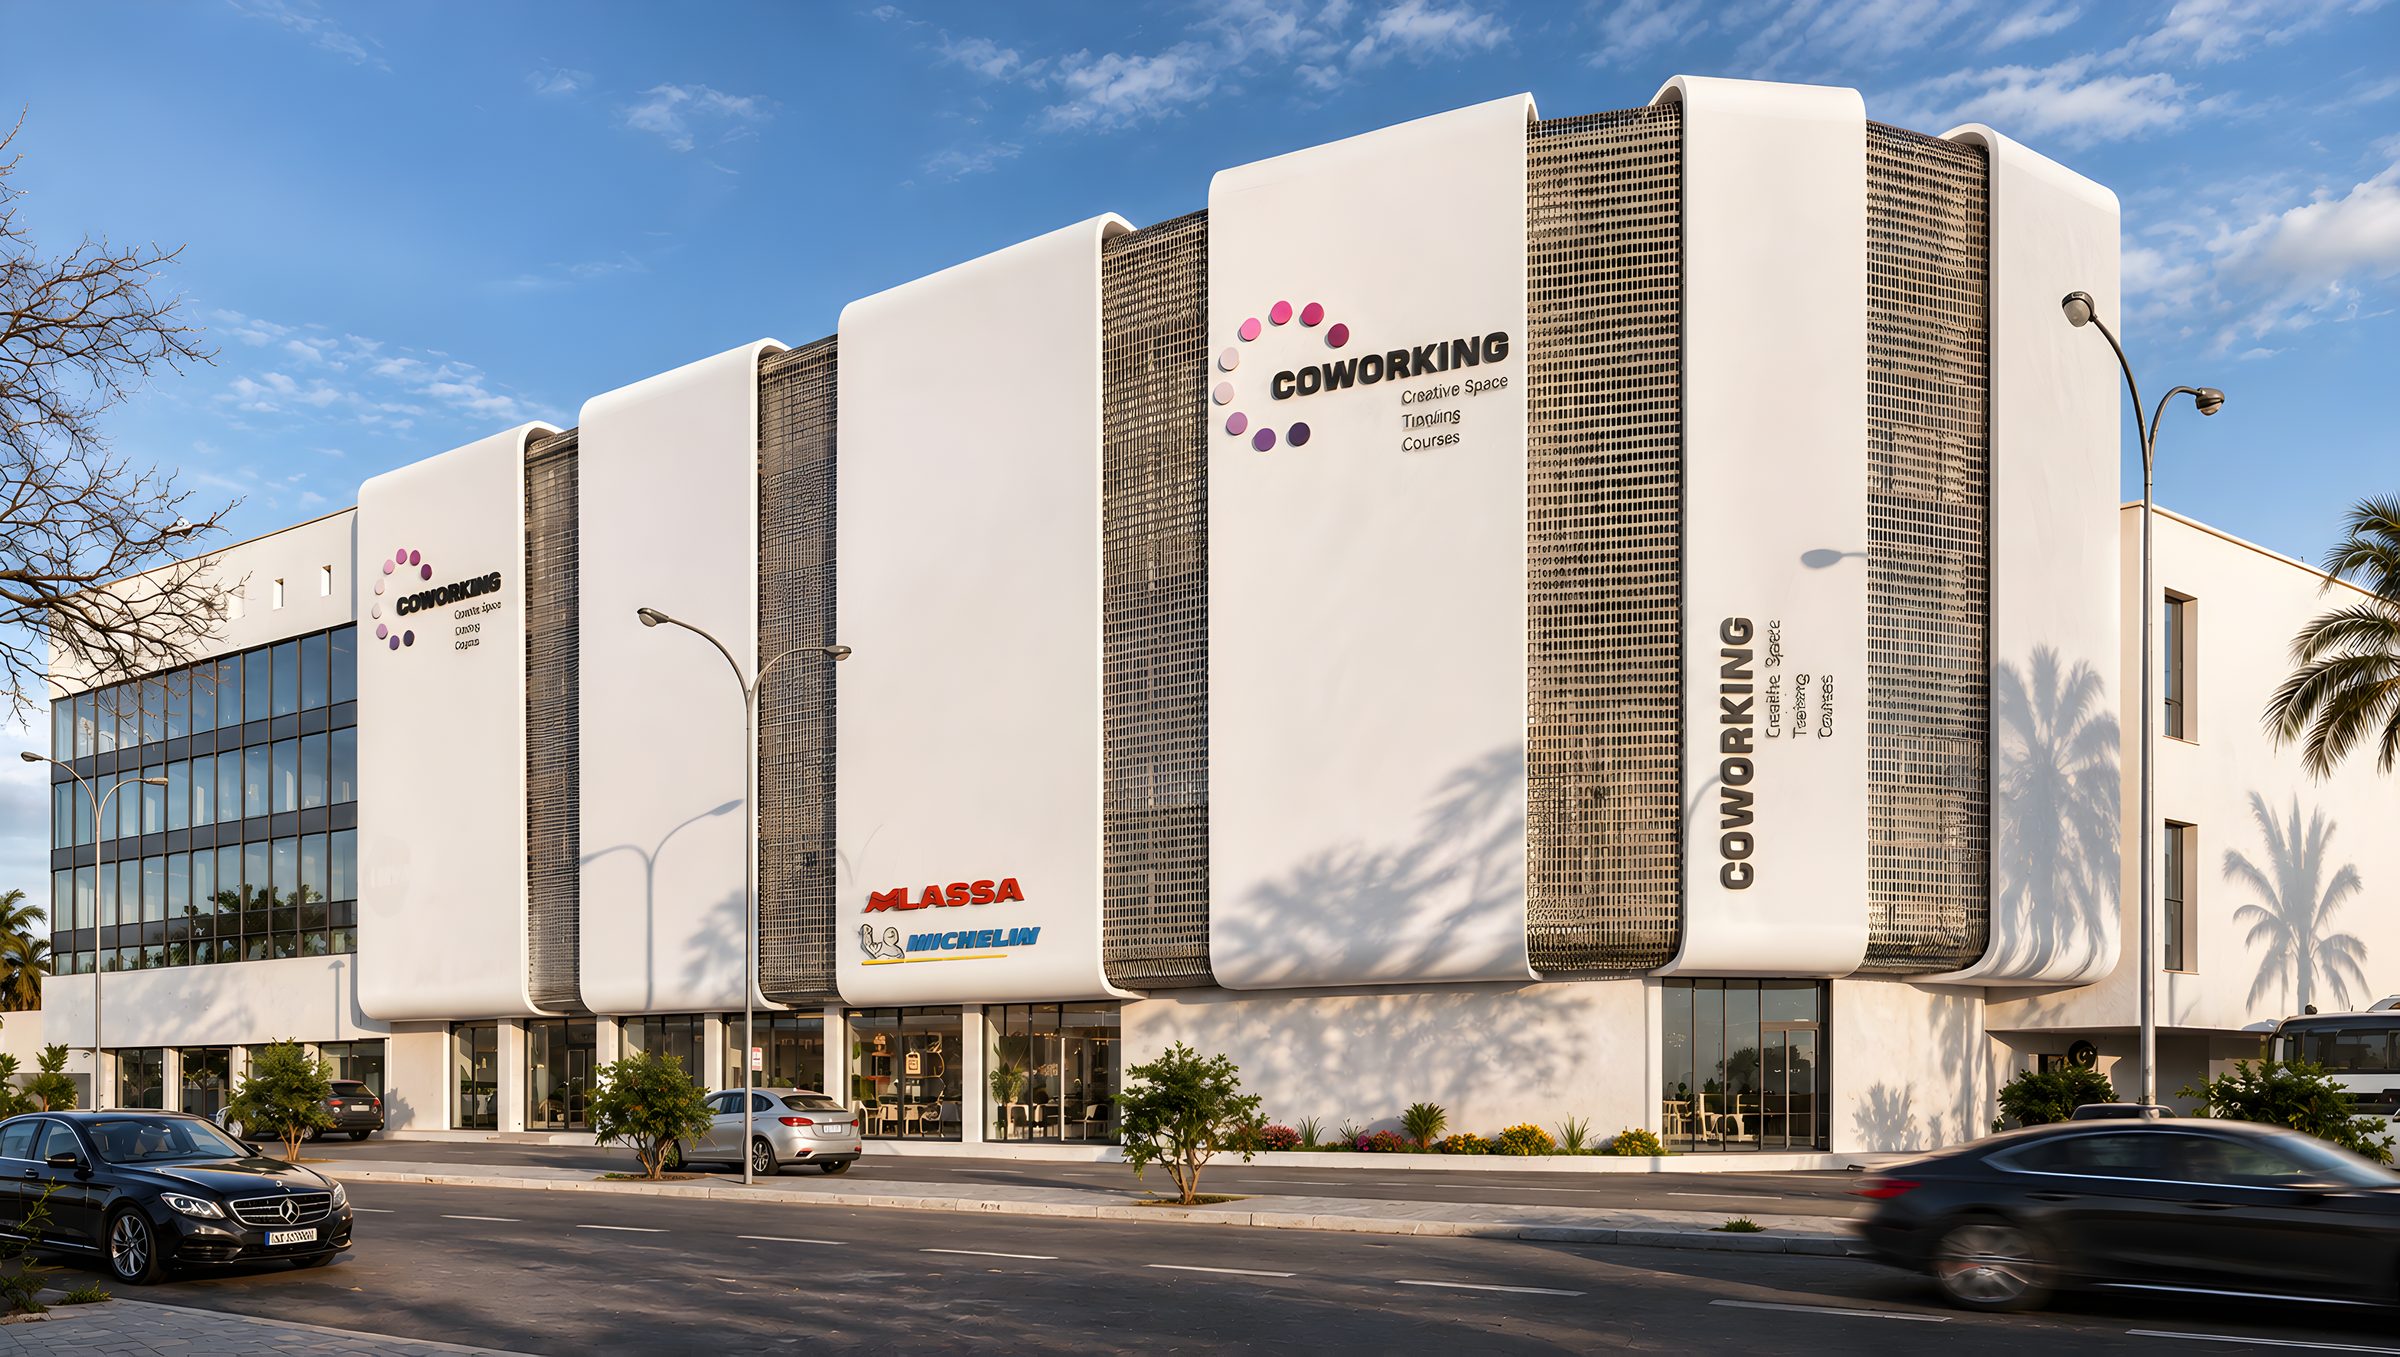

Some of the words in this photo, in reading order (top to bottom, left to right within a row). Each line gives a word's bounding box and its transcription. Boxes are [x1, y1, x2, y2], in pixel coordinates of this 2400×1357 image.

[1271, 331, 1509, 400] COWORKING
[1402, 384, 1460, 404] Creative
[1465, 377, 1508, 397] Space
[1402, 433, 1460, 451] Courses
[396, 571, 502, 616] COWORKING
[1720, 616, 1754, 890] COWORKING
[906, 926, 1041, 952] MICHELIN
